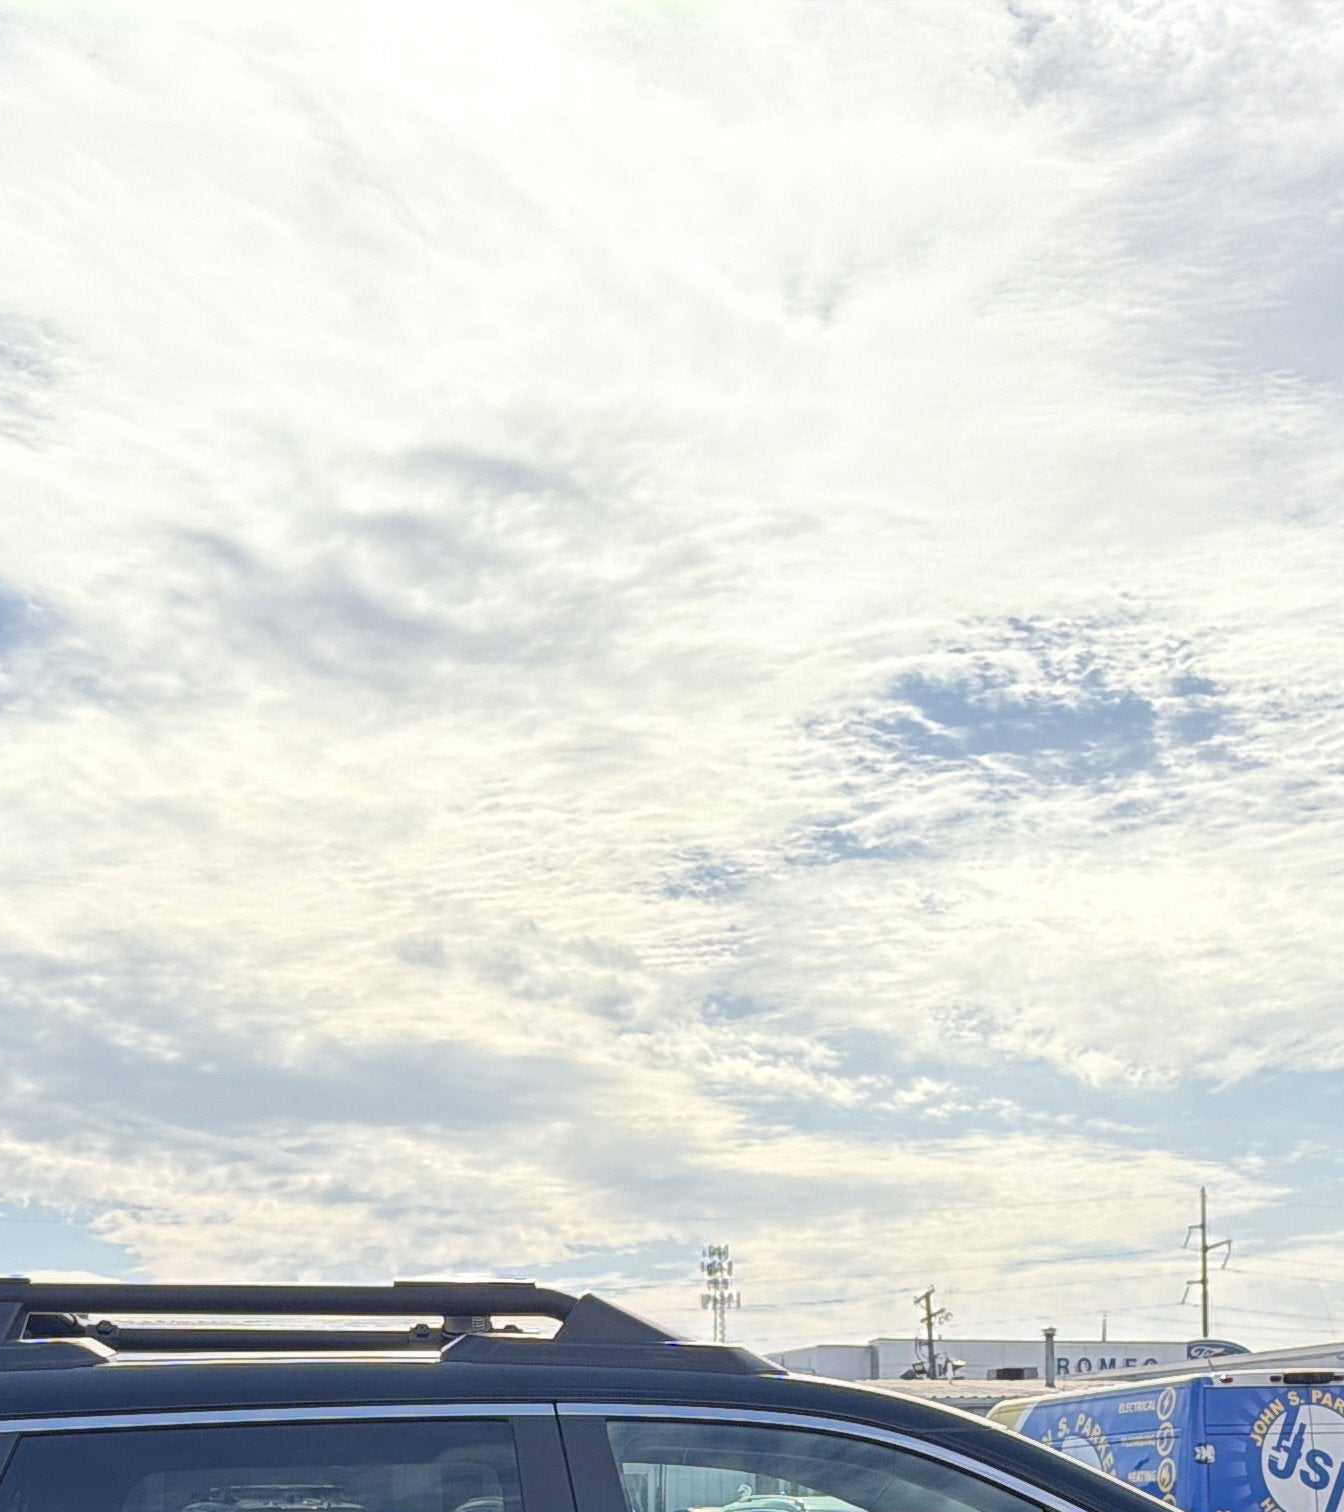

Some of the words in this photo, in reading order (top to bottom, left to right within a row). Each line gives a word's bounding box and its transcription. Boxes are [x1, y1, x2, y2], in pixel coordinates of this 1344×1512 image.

[1118, 1400, 1156, 1415] ELECTRICAL
[1250, 1398, 1285, 1447] JOHN
[1287, 1391, 1306, 1406] S.
